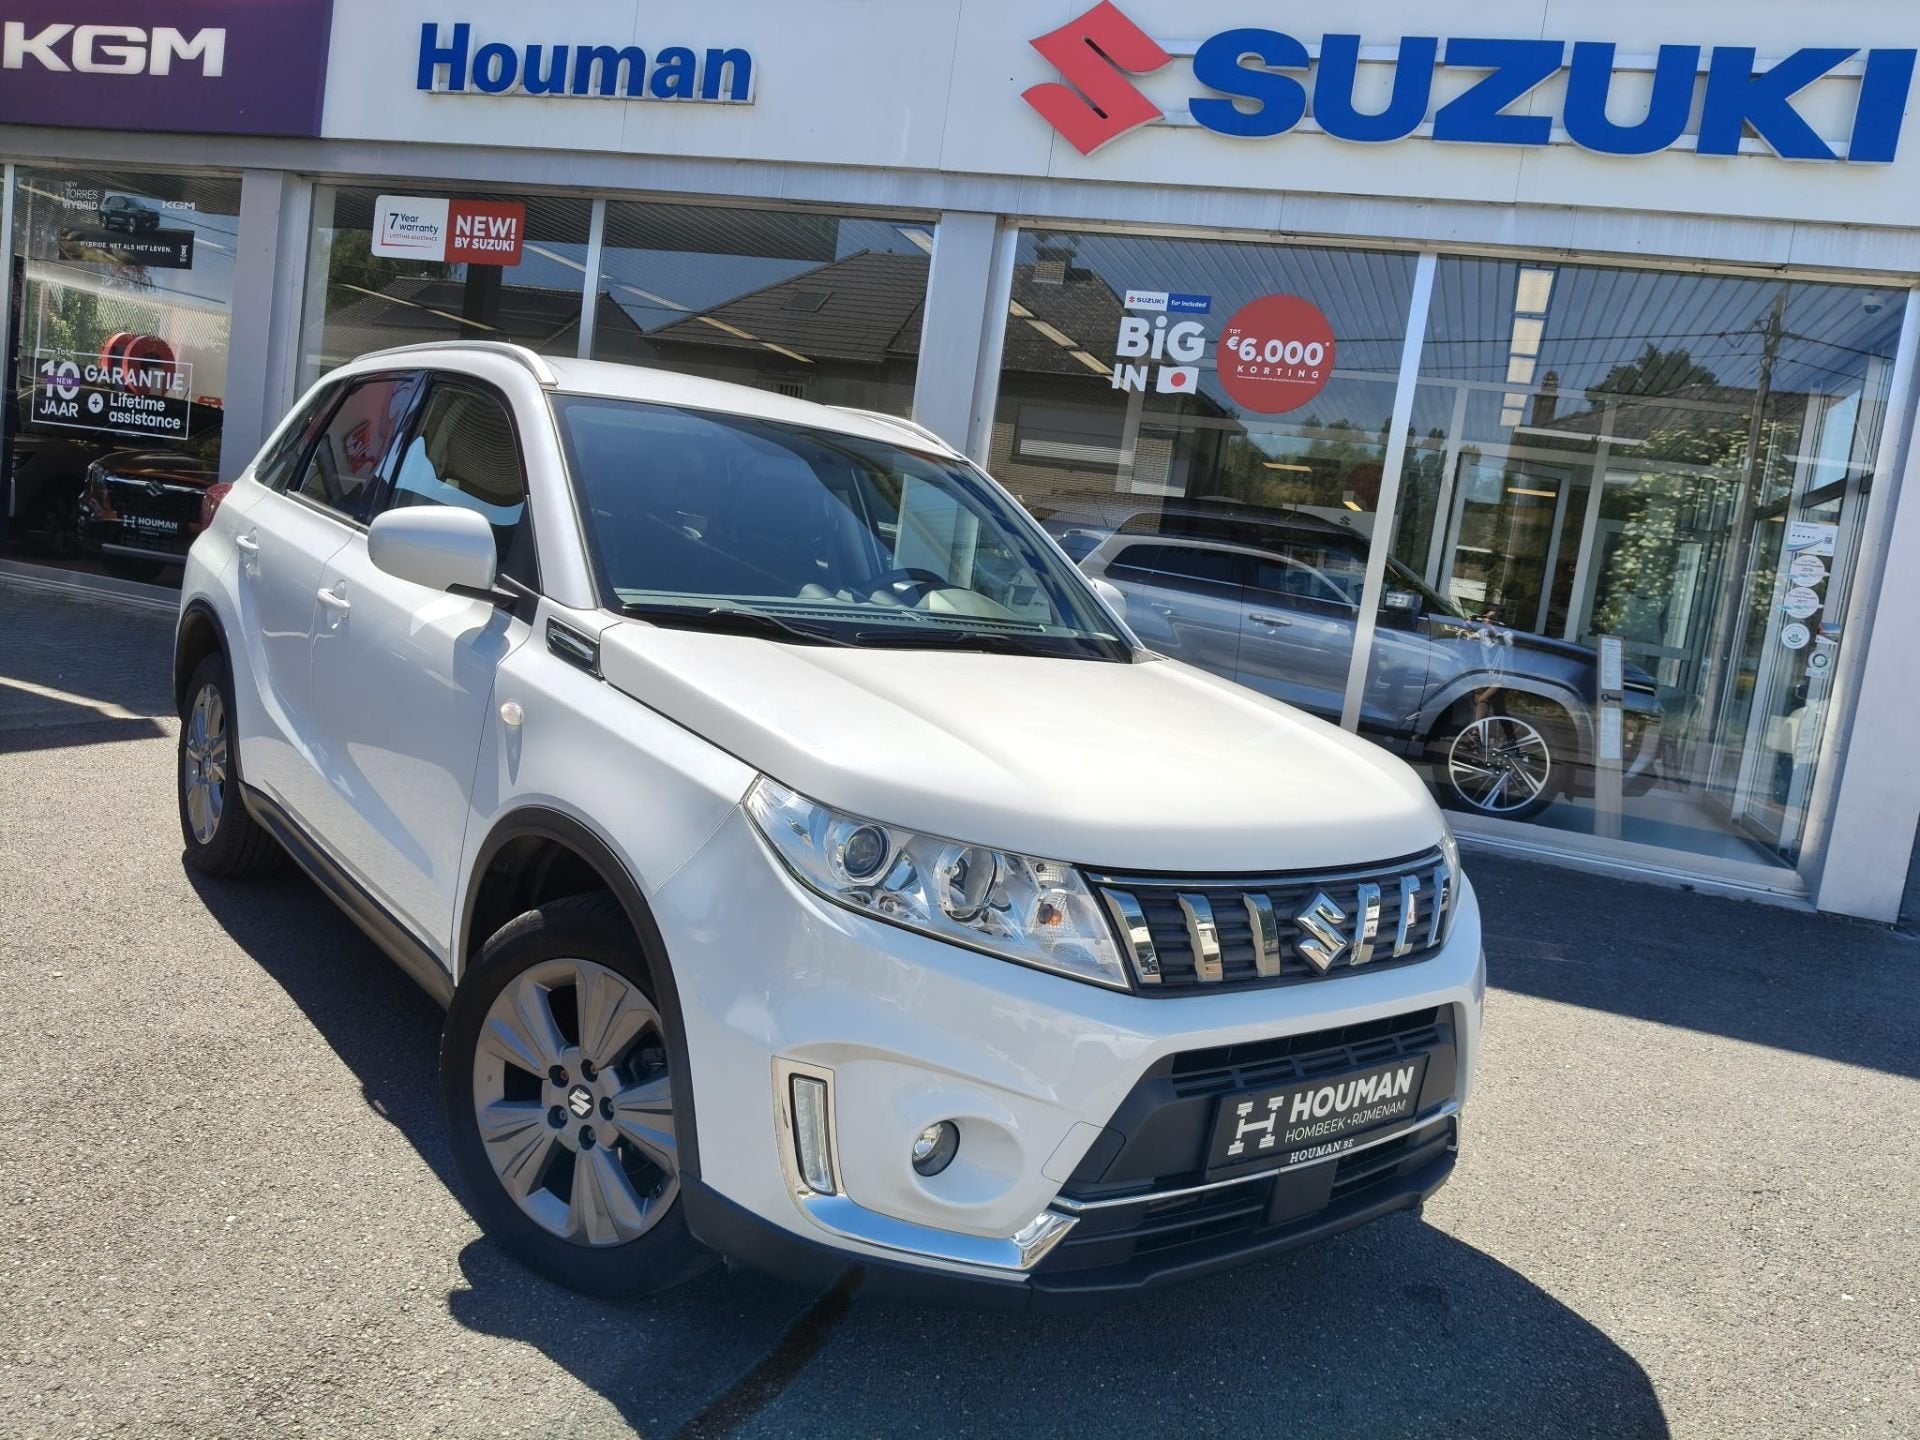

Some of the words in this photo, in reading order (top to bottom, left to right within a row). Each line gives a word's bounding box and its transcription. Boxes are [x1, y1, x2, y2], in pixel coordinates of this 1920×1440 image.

[2, 20, 227, 78] KGM
[416, 22, 756, 103] Houman
[1187, 26, 1918, 165] SUZUKI
[65, 188, 98, 200] TORRES
[63, 200, 98, 211] HYBRID
[162, 201, 195, 211] KGM
[389, 212, 399, 230] 7
[400, 213, 419, 222] Year
[399, 223, 439, 235] warranty
[455, 214, 517, 240] NEW!
[454, 236, 470, 248] BY
[40, 360, 81, 400] 10
[56, 377, 73, 385] NEW
[84, 364, 184, 391] GARANTIE
[1111, 363, 1149, 392] IN
[1237, 365, 1319, 378] KORTING
[39, 400, 79, 418] JAAR
[109, 392, 166, 411] Lifetime
[109, 409, 181, 430] assistance
[138, 517, 178, 529] HOUMAN
[1289, 1066, 1414, 1123] HOUMAN
[1284, 1116, 1347, 1144] HOMBEEK
[1351, 1100, 1406, 1126] RIJMENAM
[1289, 1138, 1354, 1163] HOUMAN.BE
